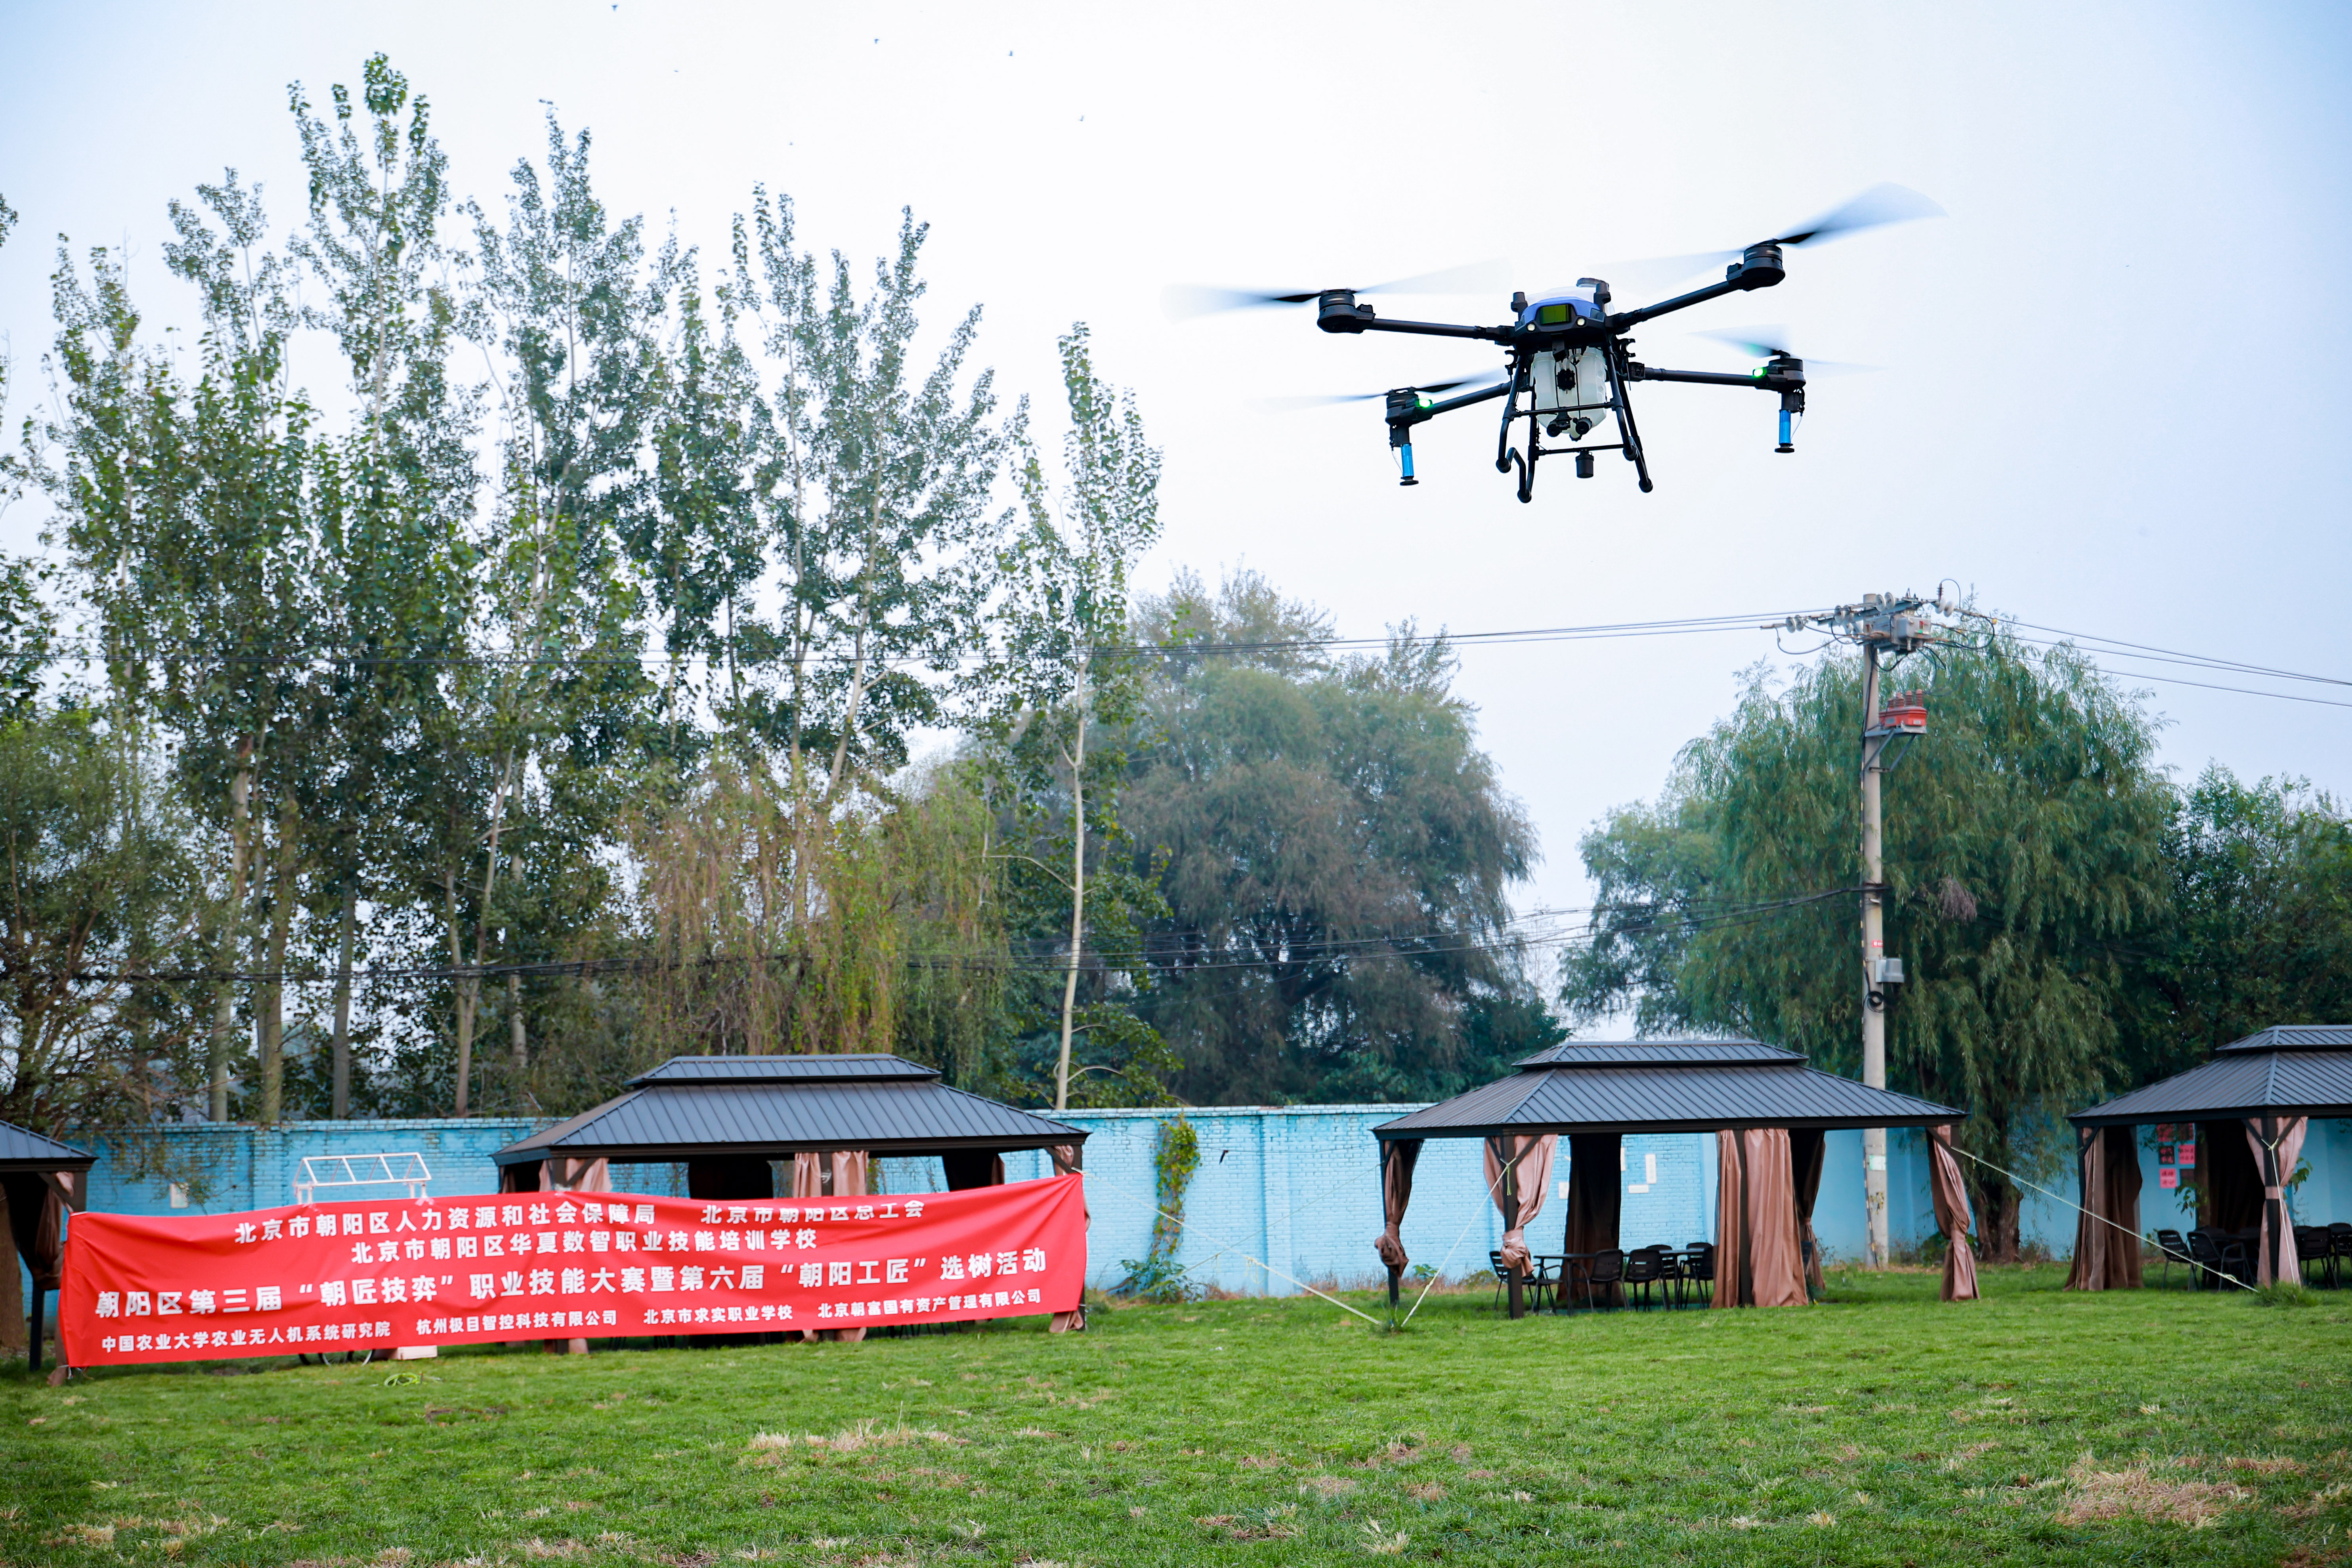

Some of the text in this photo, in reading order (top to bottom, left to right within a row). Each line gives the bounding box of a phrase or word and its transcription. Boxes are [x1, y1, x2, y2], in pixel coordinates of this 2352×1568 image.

[235, 1200, 925, 1243] 北京市朝阳区人力资源和社会保障局 北京市朝阳区总工会
[351, 1228, 817, 1264] 北京市朝阳区华夏数智职业技能培训学校
[102, 1288, 1041, 1352] 中国农业大学农业无人机系统研究院 杭州极目智控科技有限公司 北京市求实职业学校 北京朝富国有资产管理有限公司
